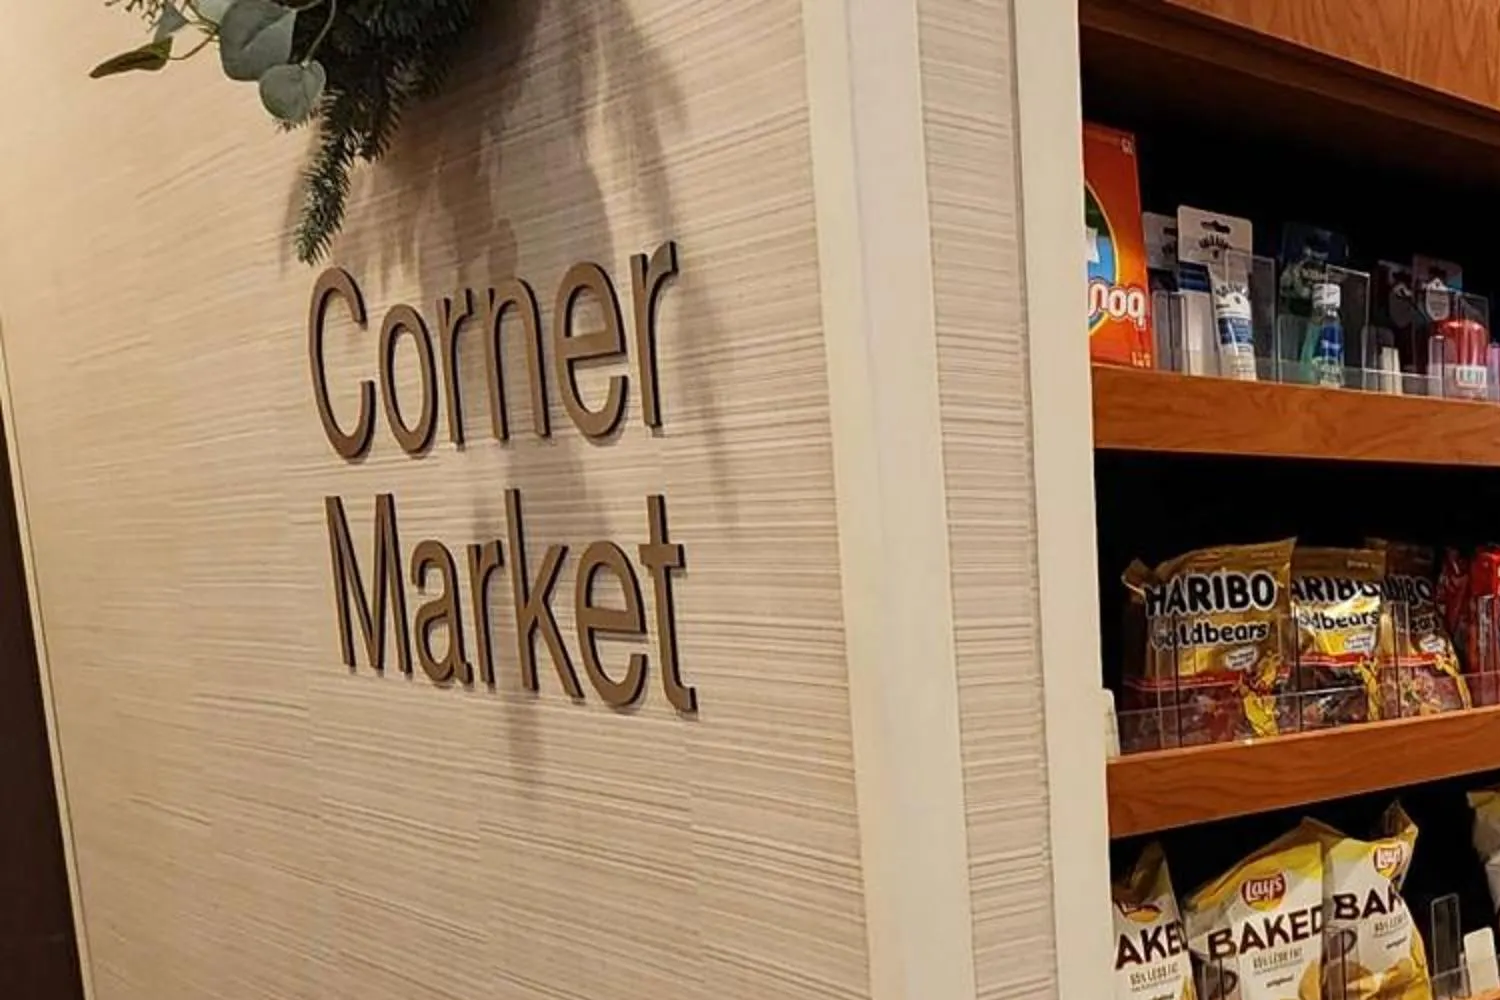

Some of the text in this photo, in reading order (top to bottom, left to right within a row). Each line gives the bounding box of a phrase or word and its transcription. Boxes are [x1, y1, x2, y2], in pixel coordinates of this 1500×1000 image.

[309, 241, 678, 458] Corner
[325, 488, 698, 712] Market
[1144, 572, 1277, 618] HARIBO
[1290, 575, 1381, 602] ARIBO
[1115, 919, 1189, 971] AKED
